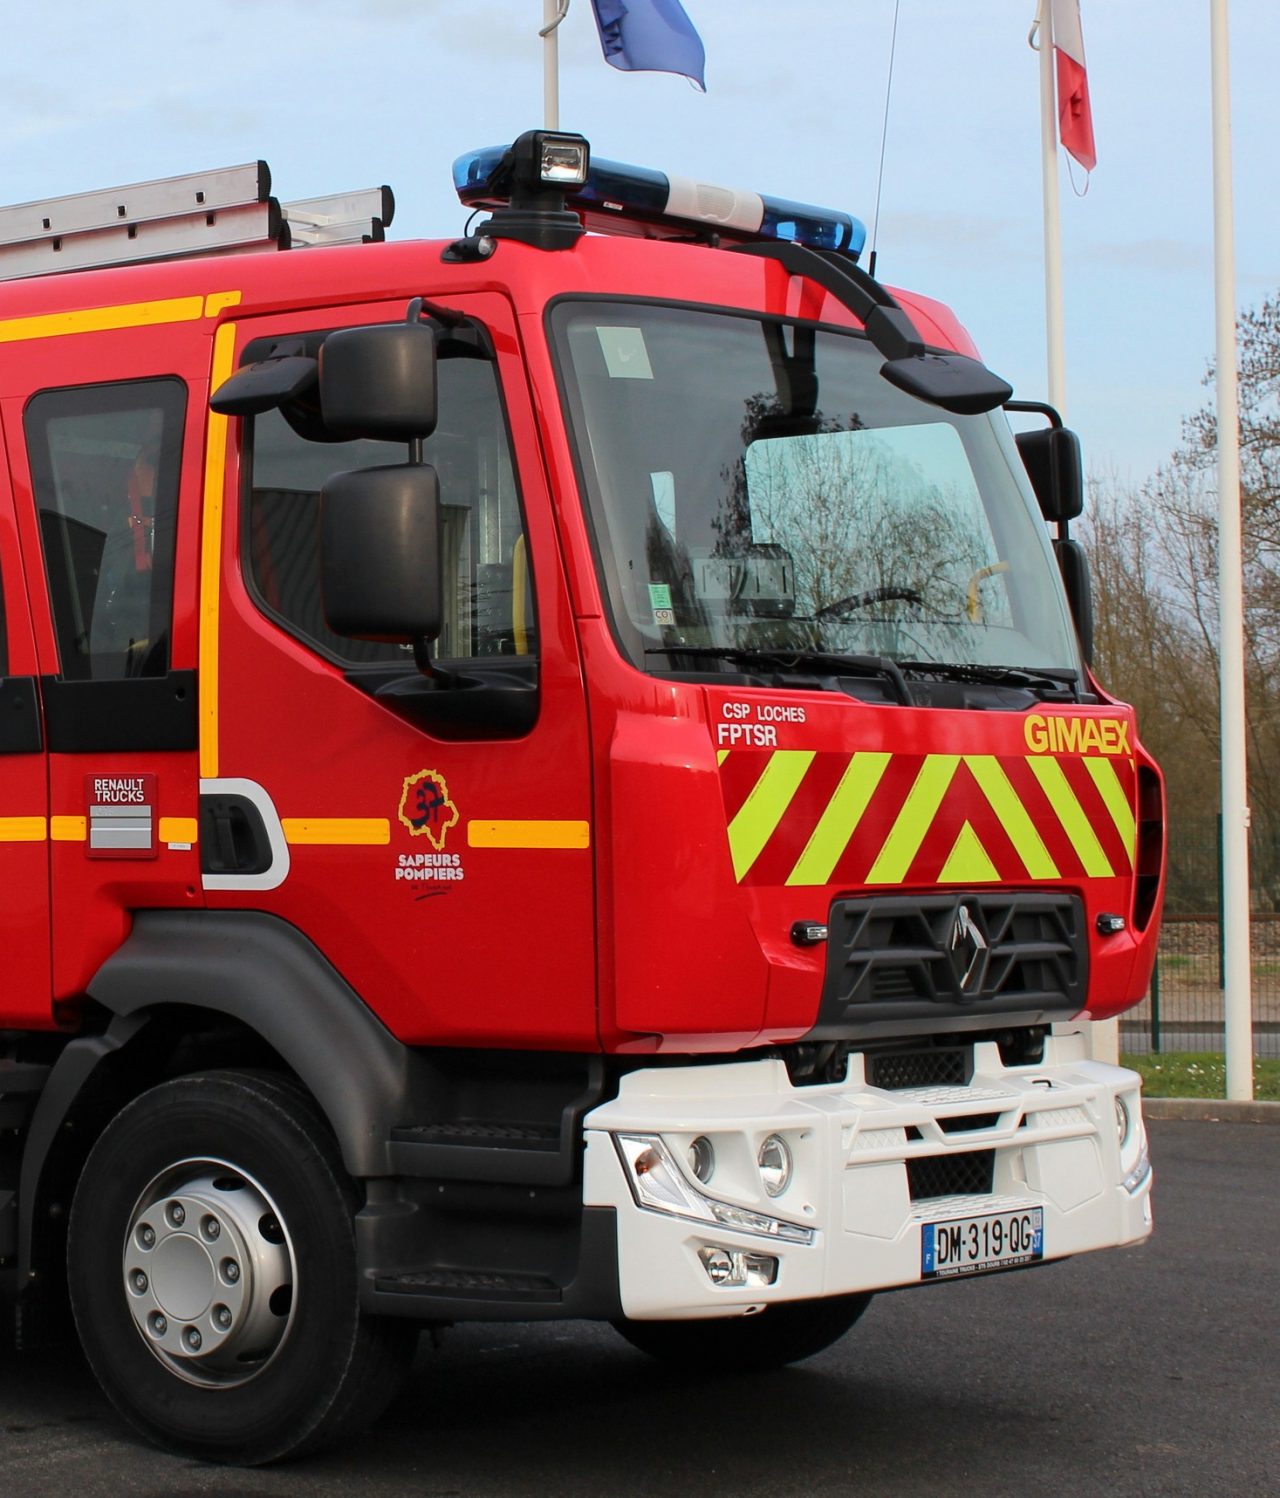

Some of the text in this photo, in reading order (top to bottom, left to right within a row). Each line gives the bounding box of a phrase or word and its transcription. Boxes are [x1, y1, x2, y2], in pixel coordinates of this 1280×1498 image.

[722, 703, 806, 723] CSP LOCHES
[717, 723, 777, 747] FPTSR
[1024, 714, 1132, 755] GIMAEX
[94, 778, 144, 791] RENAULT
[95, 790, 145, 802] TRUCKS
[398, 853, 461, 867] SAPEURS
[395, 867, 464, 881] POMPIERS
[937, 1215, 1031, 1264] DM-319-QG
